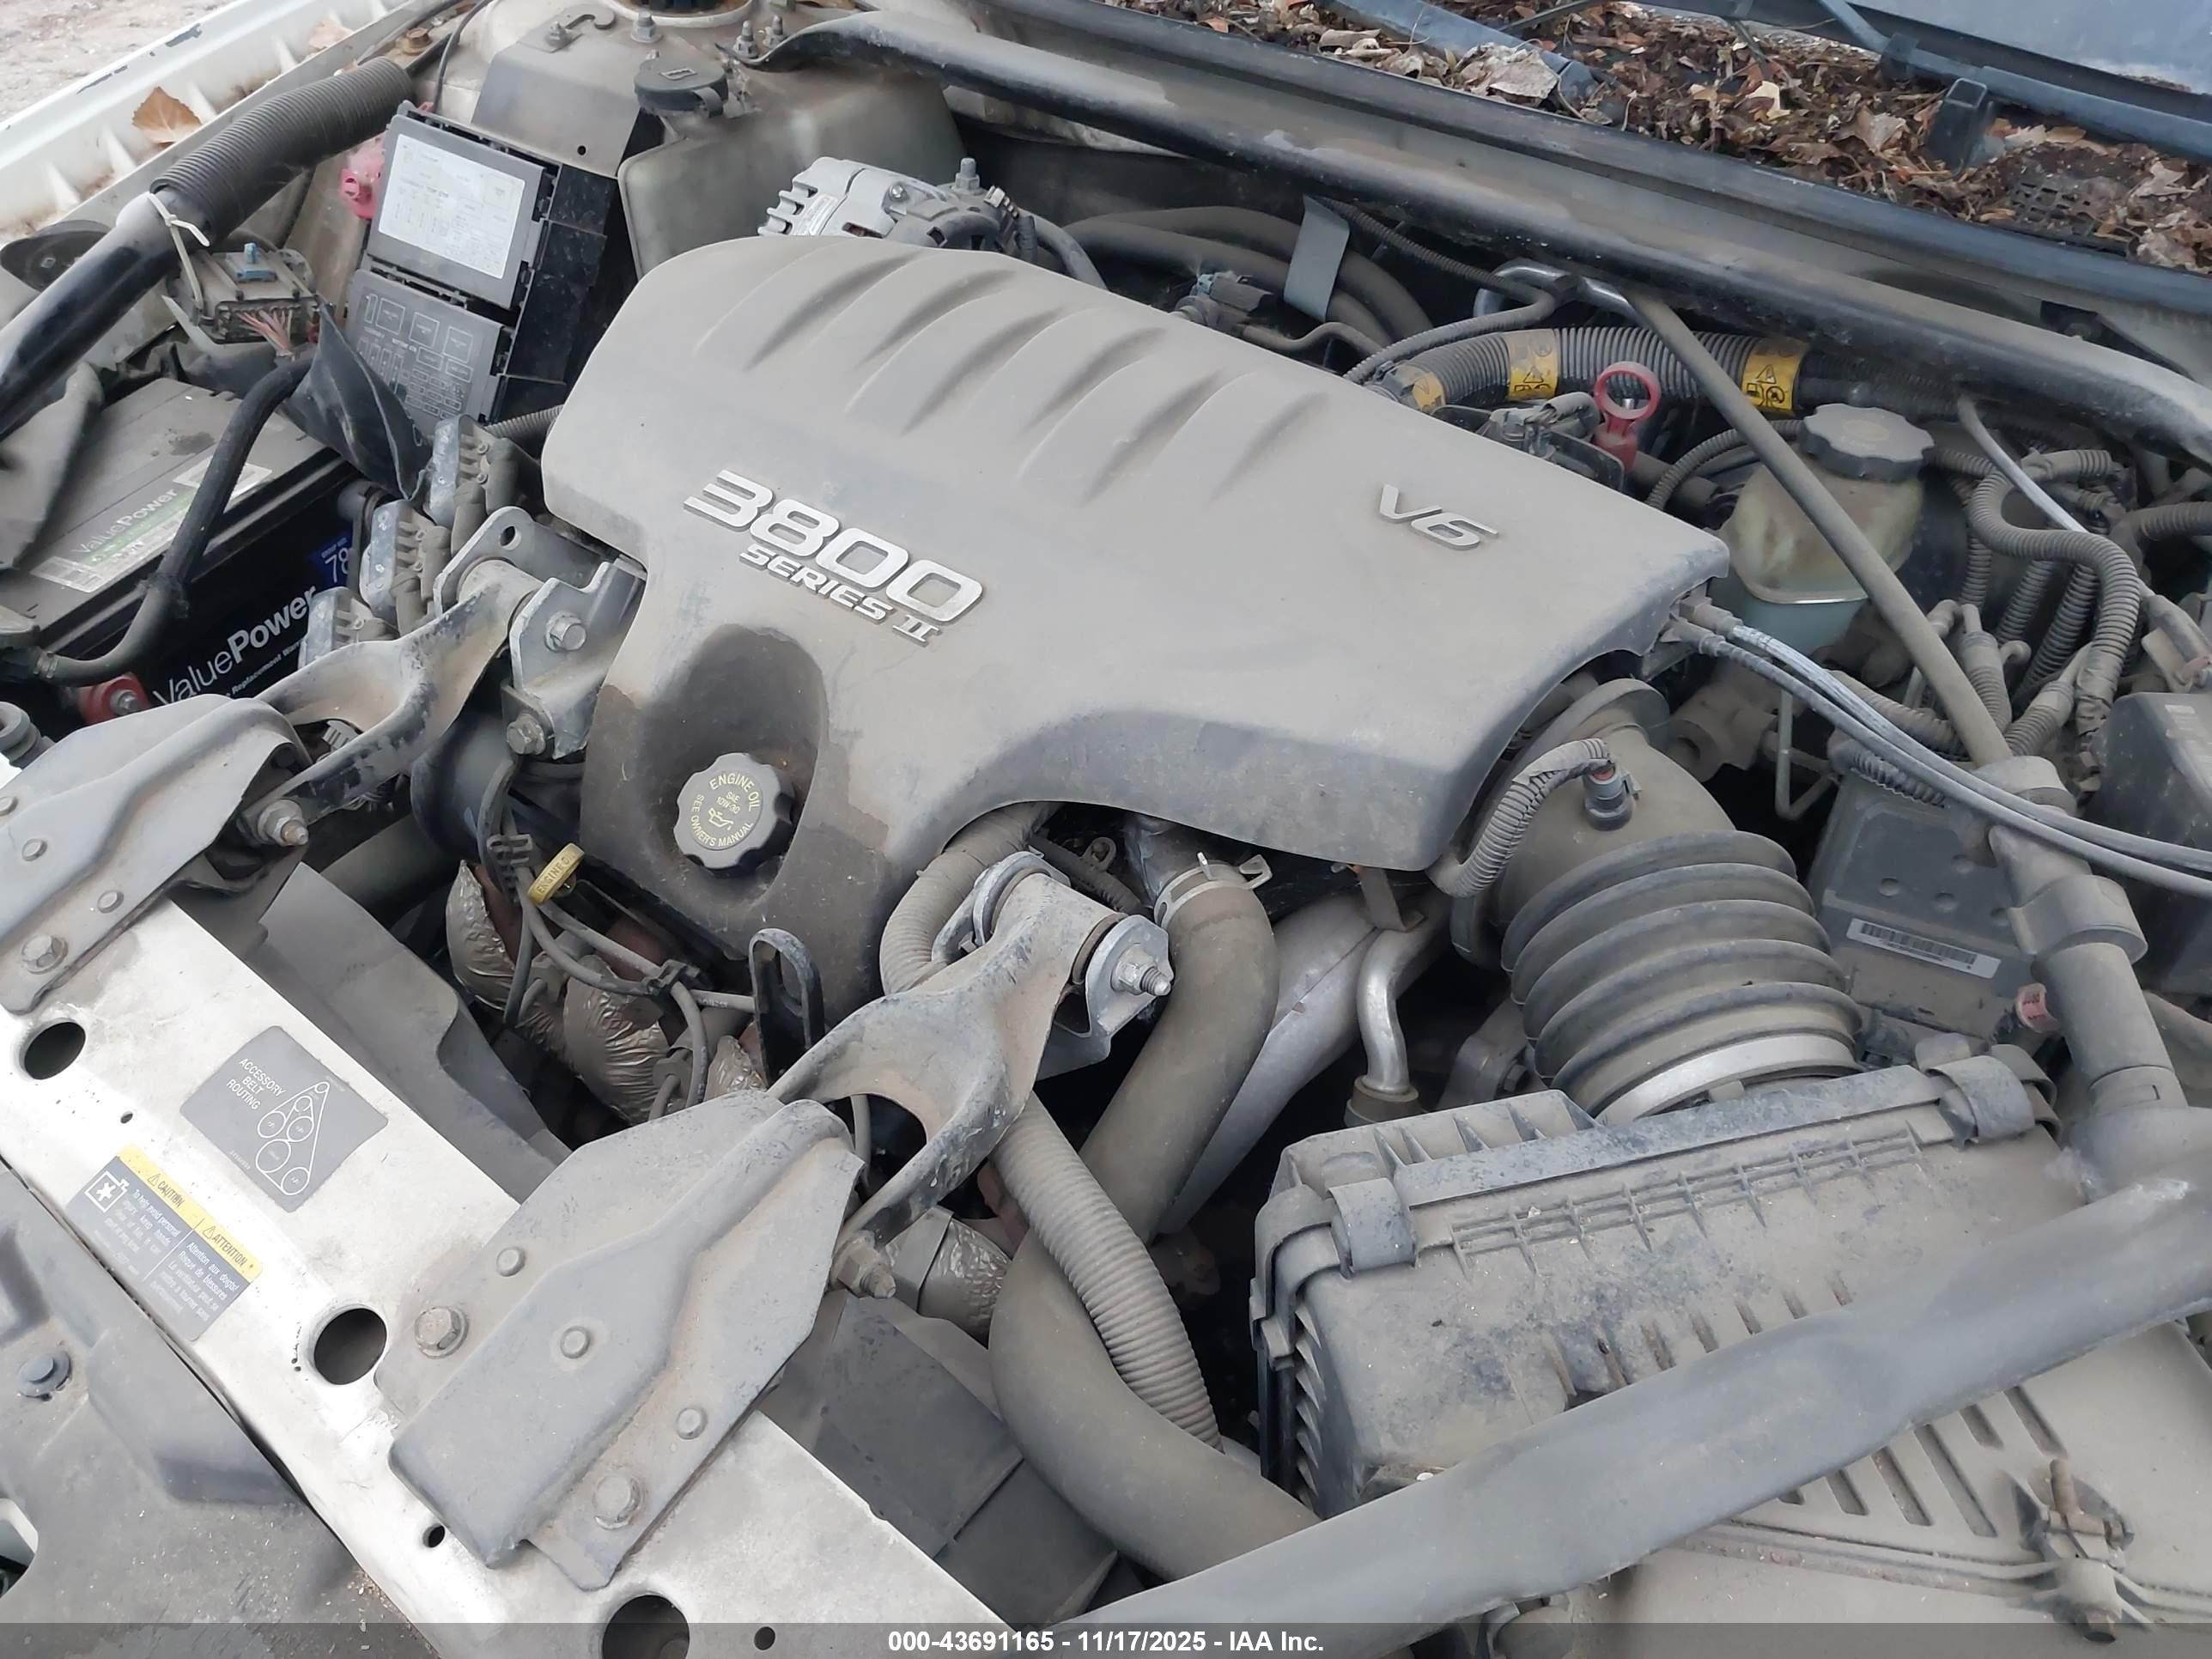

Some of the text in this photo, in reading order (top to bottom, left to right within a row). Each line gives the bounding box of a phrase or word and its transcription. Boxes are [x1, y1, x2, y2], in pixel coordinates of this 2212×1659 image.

[73, 488, 179, 554] ValuePower
[1379, 483, 1498, 551] V6
[683, 469, 983, 623] 3800
[739, 543, 941, 647] SERIES II
[153, 586, 316, 704] ValuePower
[709, 773, 761, 812] ENGINE OIL
[690, 793, 705, 812] SEE
[718, 823, 754, 847] MANUAL
[226, 1079, 261, 1110] ROUTING
[240, 1059, 286, 1097] ACCESSORY
[242, 1075, 264, 1096] BELT
[157, 1181, 185, 1208] CAUTION
[211, 1234, 247, 1267] ATTENTION
